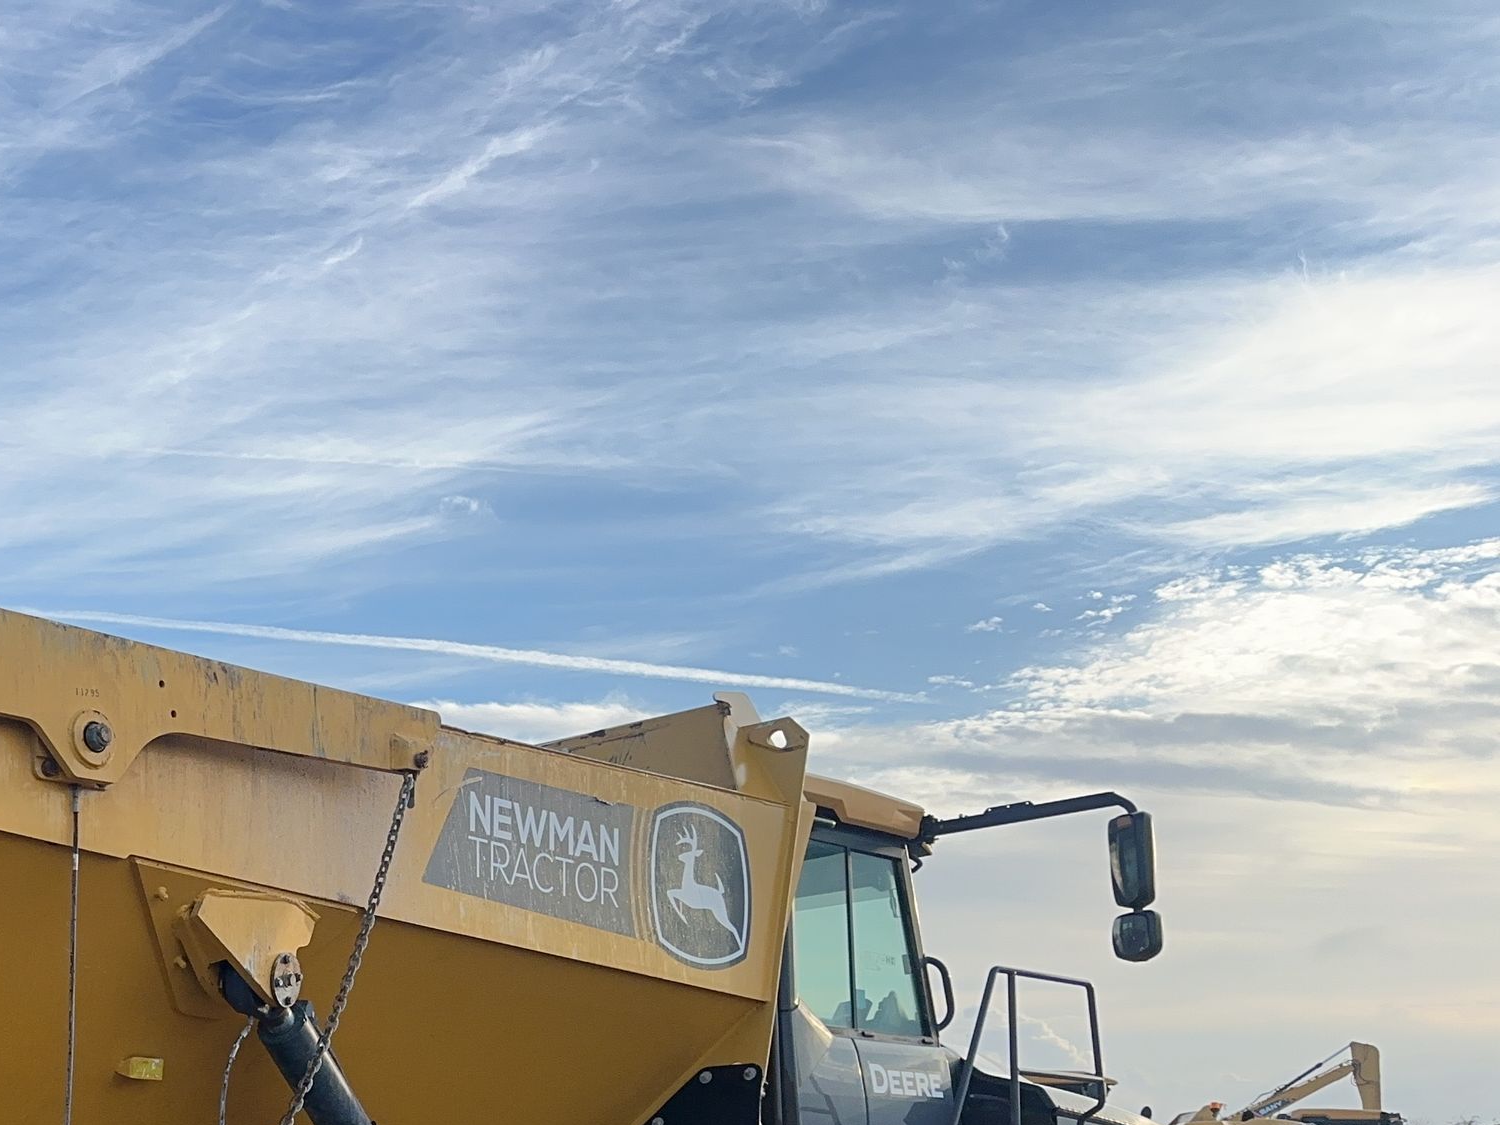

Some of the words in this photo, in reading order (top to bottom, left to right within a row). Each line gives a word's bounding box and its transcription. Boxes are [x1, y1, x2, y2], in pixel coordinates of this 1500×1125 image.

[468, 791, 619, 866] NEWMAN
[468, 835, 619, 908] TRACTOR
[868, 1062, 944, 1099] DEERE
